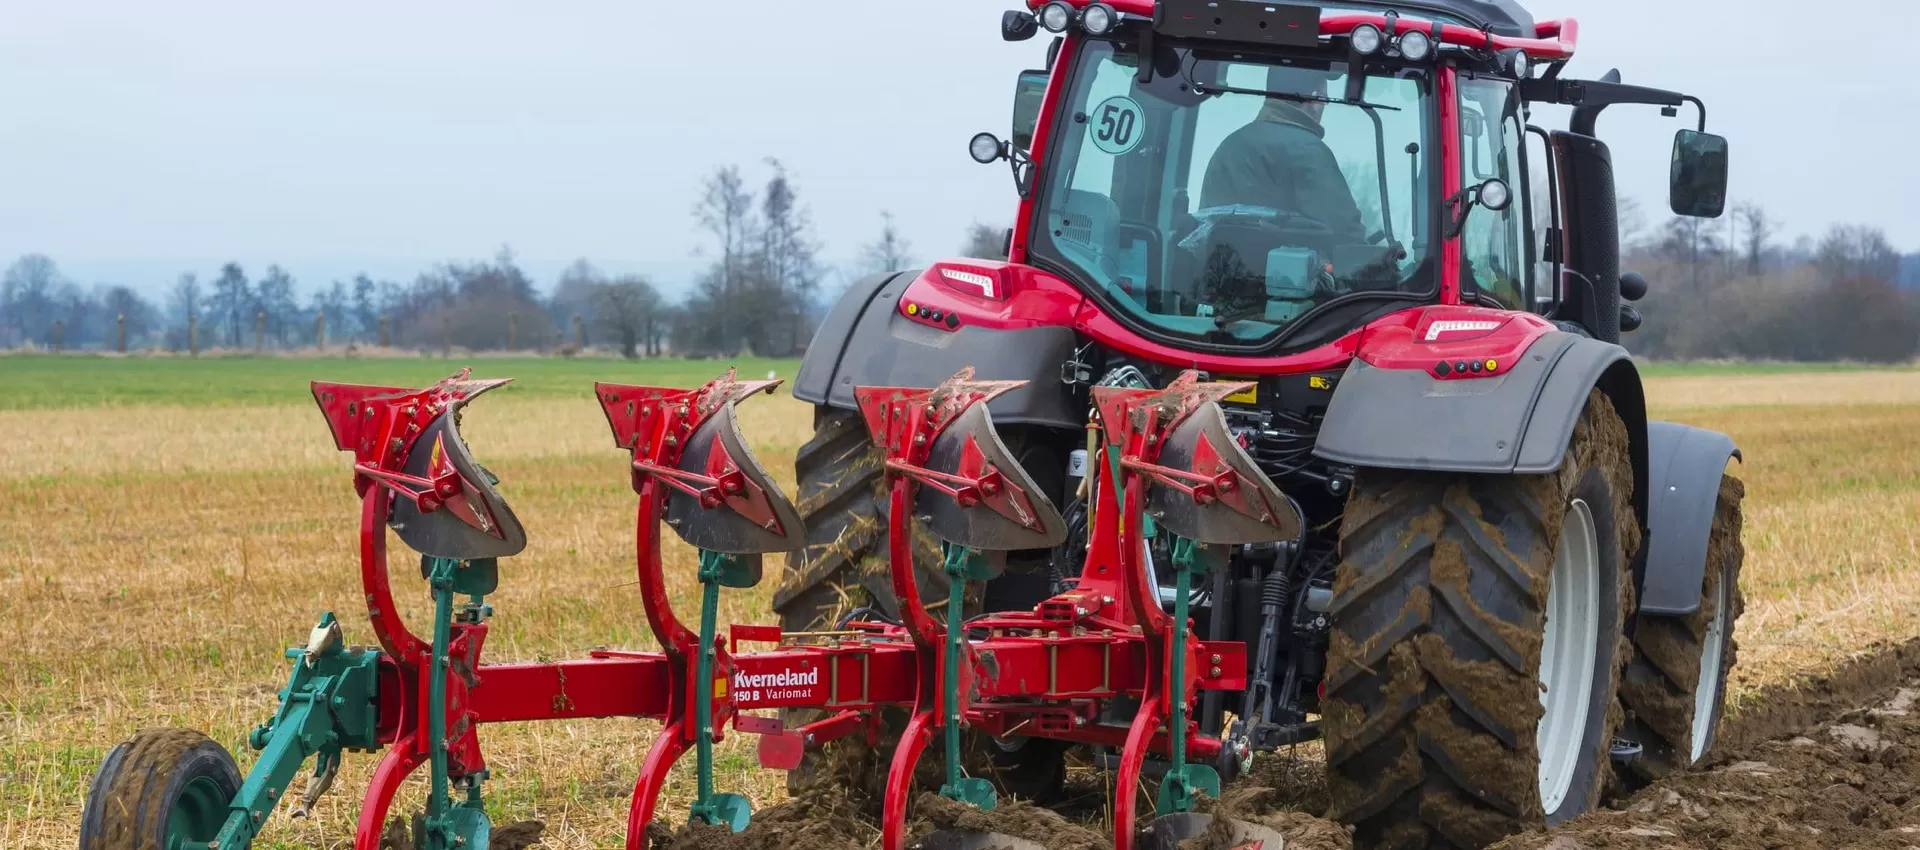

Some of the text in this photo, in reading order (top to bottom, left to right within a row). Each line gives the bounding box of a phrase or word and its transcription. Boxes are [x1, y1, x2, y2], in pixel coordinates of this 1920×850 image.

[1098, 104, 1135, 145] 50
[735, 667, 818, 688] Kverneland
[733, 688, 812, 702] 150 B Variomat
